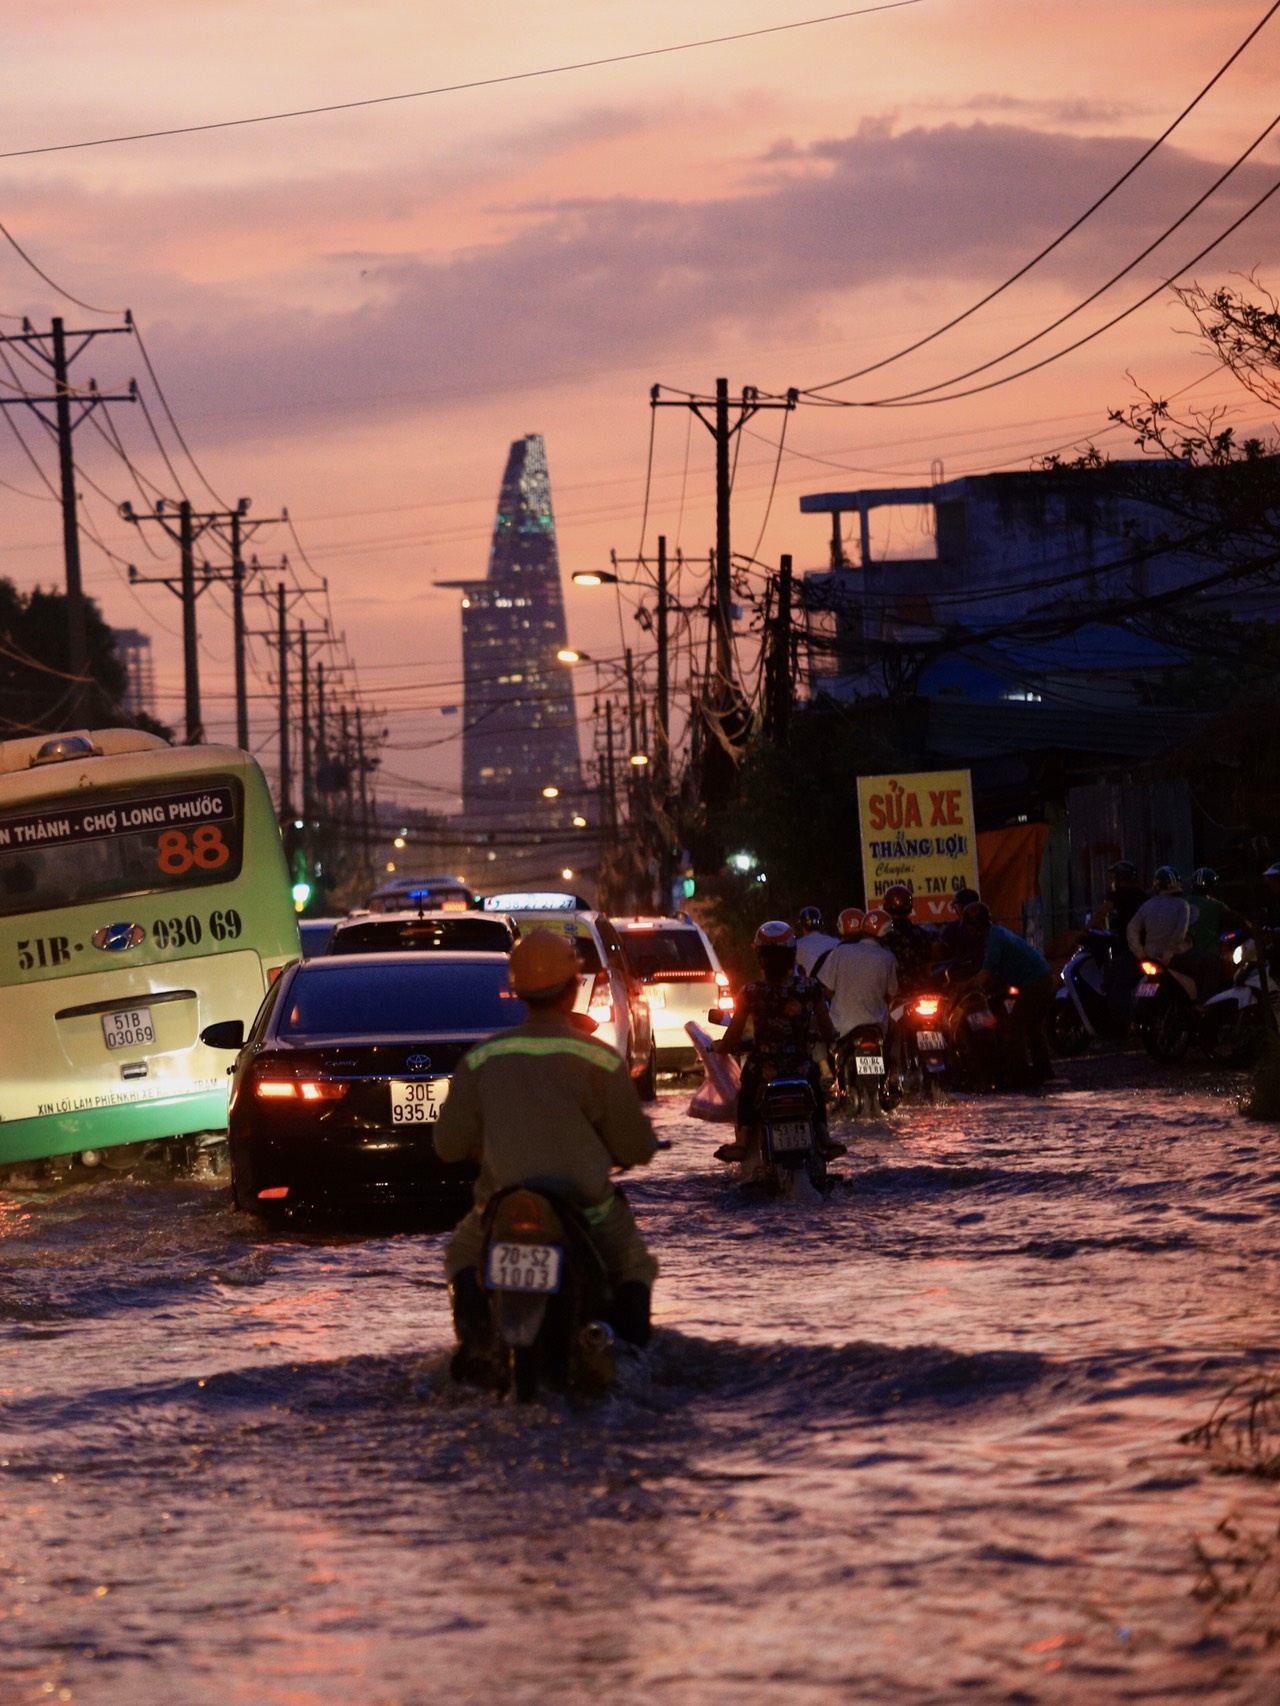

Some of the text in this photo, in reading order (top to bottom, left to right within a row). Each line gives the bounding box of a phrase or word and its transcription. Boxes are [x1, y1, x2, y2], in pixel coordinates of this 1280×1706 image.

[869, 779, 963, 830] SỬA XE
[14, 819, 70, 842] THÀNH
[83, 811, 117, 833] CHỢ
[122, 806, 166, 826] LONG
[169, 796, 223, 819] PHƯỚC
[158, 825, 229, 874] 88
[870, 832, 967, 859] THẮNG LỢI
[925, 876, 948, 893] TAY
[952, 875, 967, 890] GA
[153, 915, 202, 949] 030
[209, 909, 242, 941] 69
[114, 1012, 140, 1030] 51B
[108, 1026, 153, 1048] 030.69
[405, 1084, 436, 1101] 30E
[37, 1103, 54, 1115] XIN
[393, 1104, 438, 1121] 935.4
